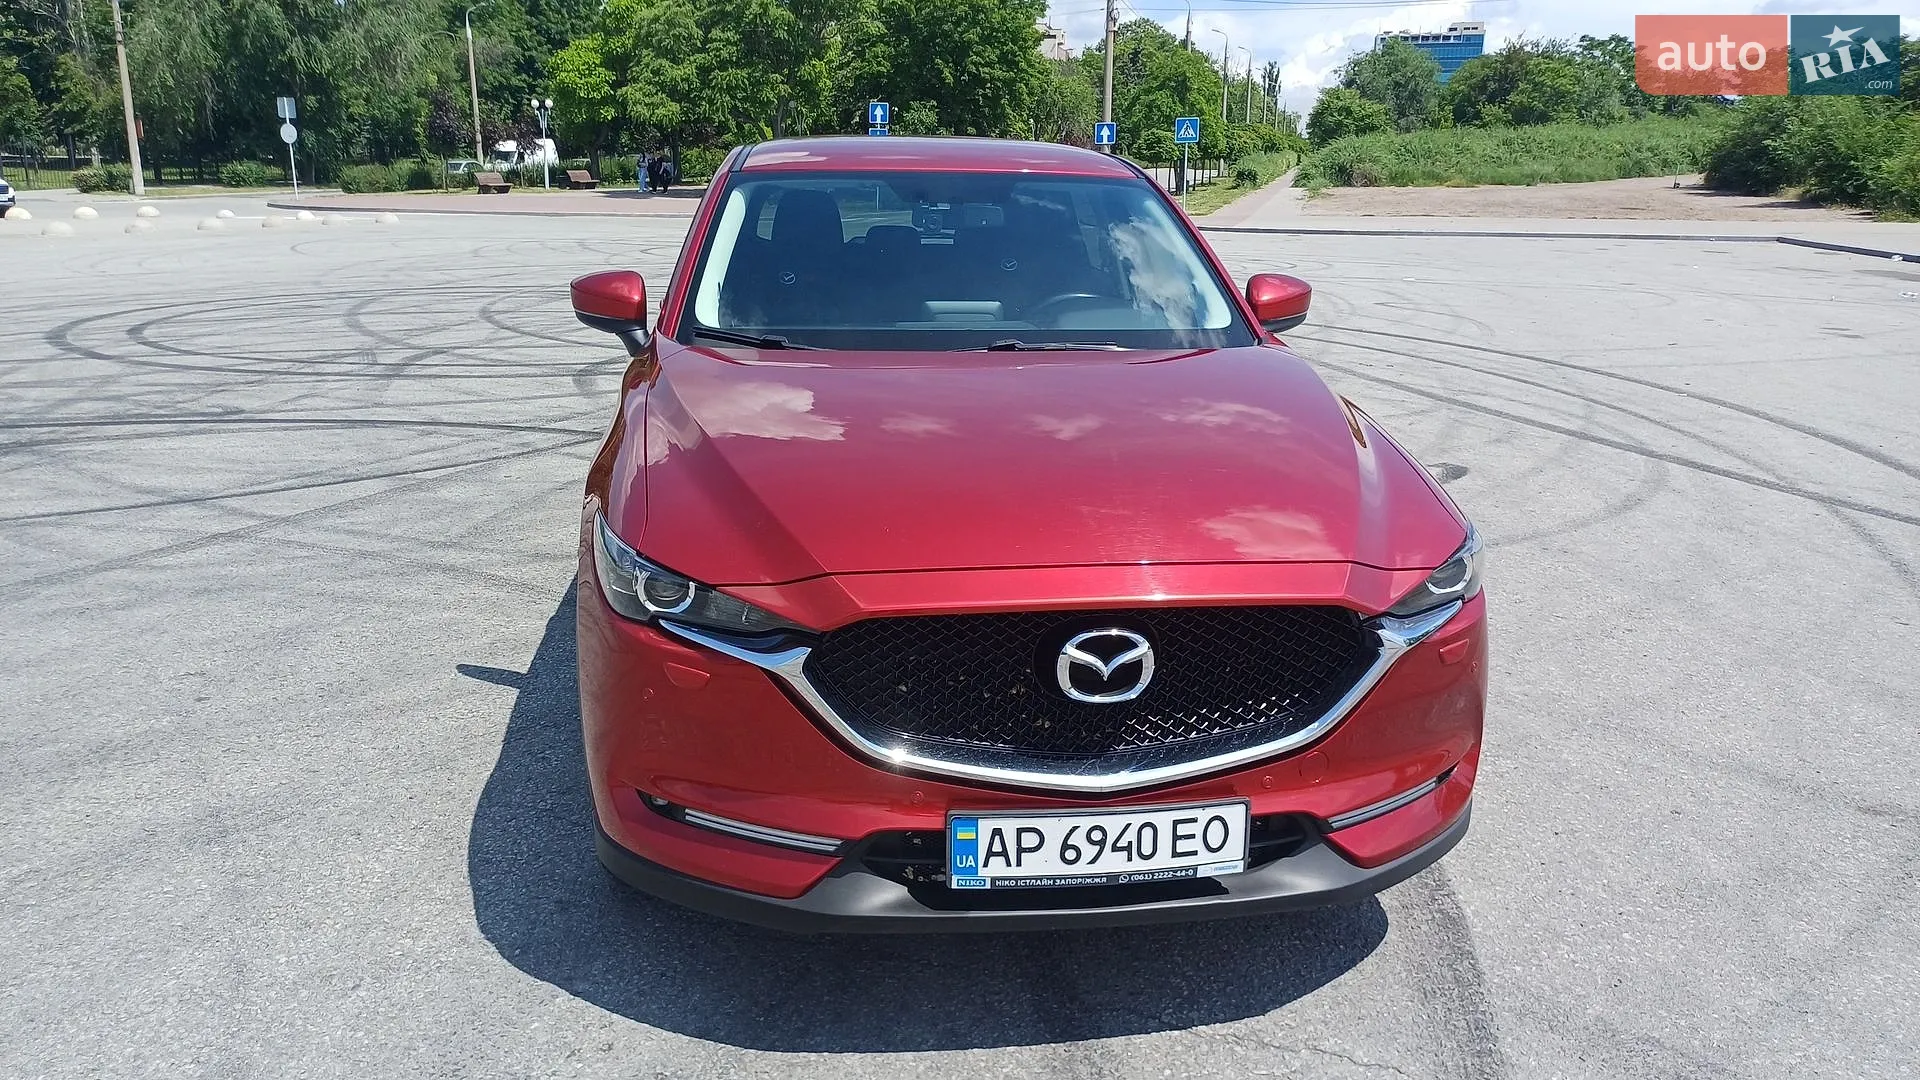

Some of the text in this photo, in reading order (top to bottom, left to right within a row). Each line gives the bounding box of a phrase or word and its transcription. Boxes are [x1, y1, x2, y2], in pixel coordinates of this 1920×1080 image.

[982, 815, 1230, 867] AP 6940 EO
[956, 855, 976, 868] UA
[1131, 873, 1153, 881] (061)
